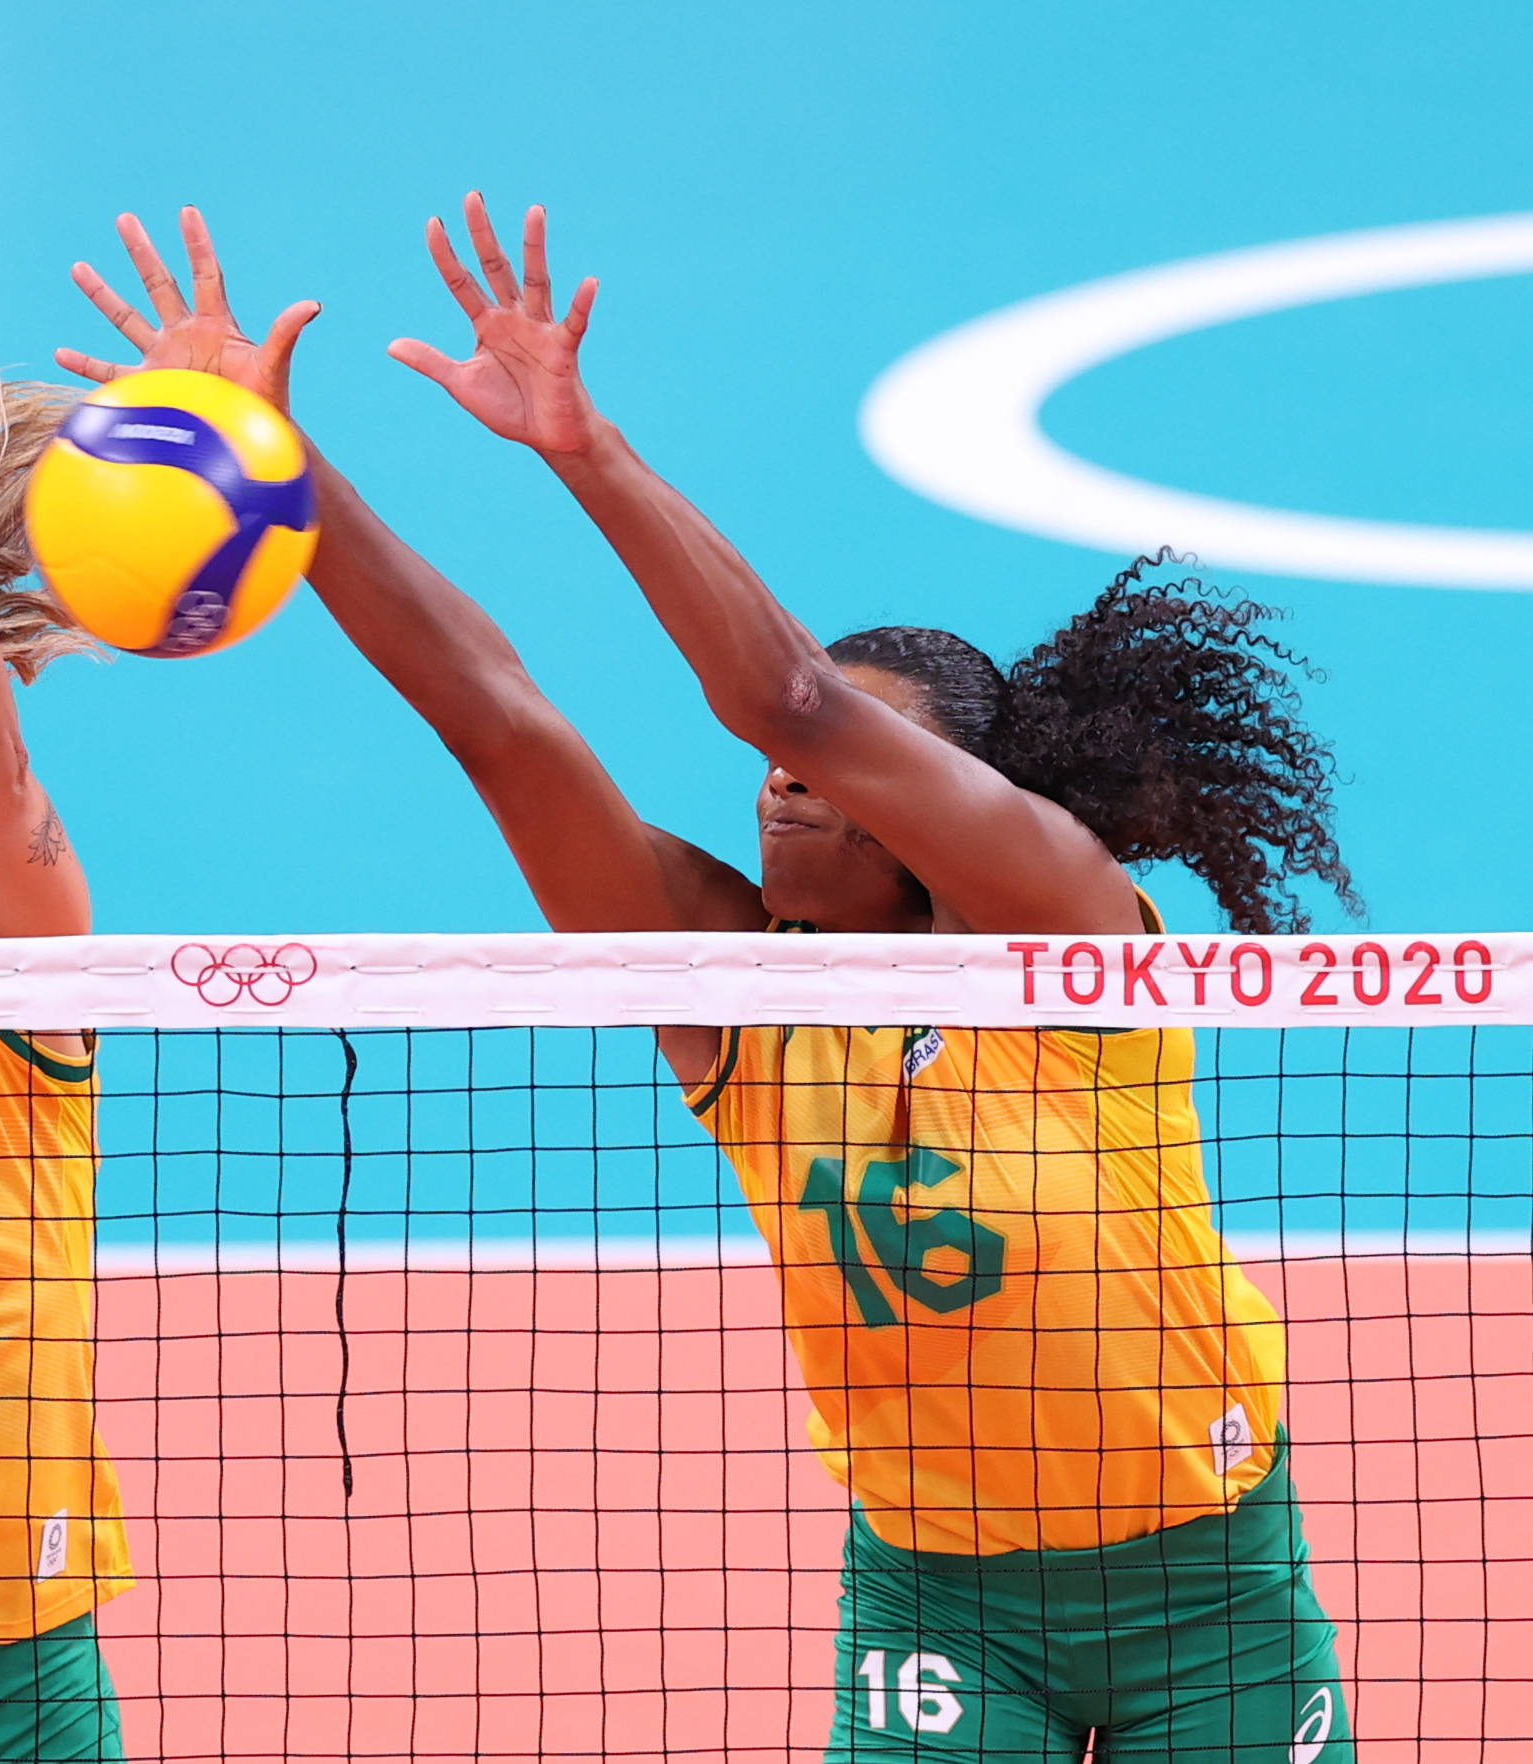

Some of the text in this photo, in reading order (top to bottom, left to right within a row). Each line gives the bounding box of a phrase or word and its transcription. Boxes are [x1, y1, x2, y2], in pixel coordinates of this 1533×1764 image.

[1007, 940, 1493, 1007] TOKYO 2020
[905, 1029, 944, 1073] BRASI
[797, 1146, 1006, 1329] 16
[857, 1649, 965, 1735] 16
